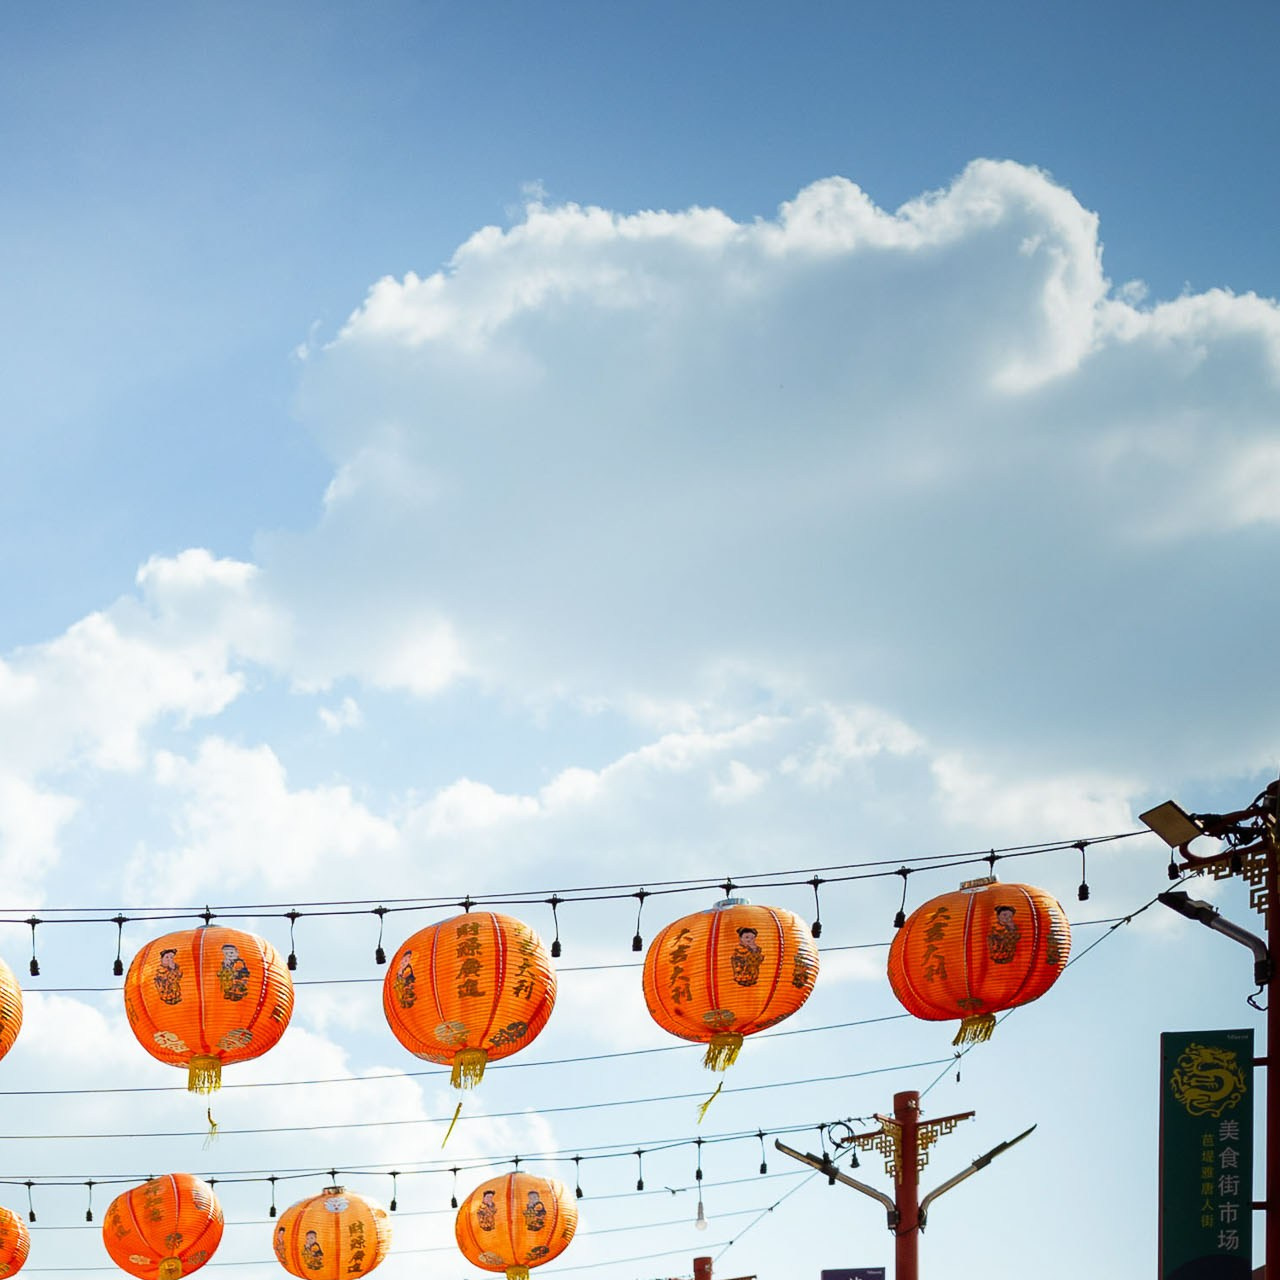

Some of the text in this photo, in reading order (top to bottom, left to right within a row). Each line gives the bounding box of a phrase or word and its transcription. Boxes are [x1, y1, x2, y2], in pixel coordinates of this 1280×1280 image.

[456, 922, 486, 998] 財源廣進
[669, 928, 694, 1005] 大吉大利
[921, 906, 952, 983] 大吉大利
[1217, 1120, 1240, 1251] 美食街市场
